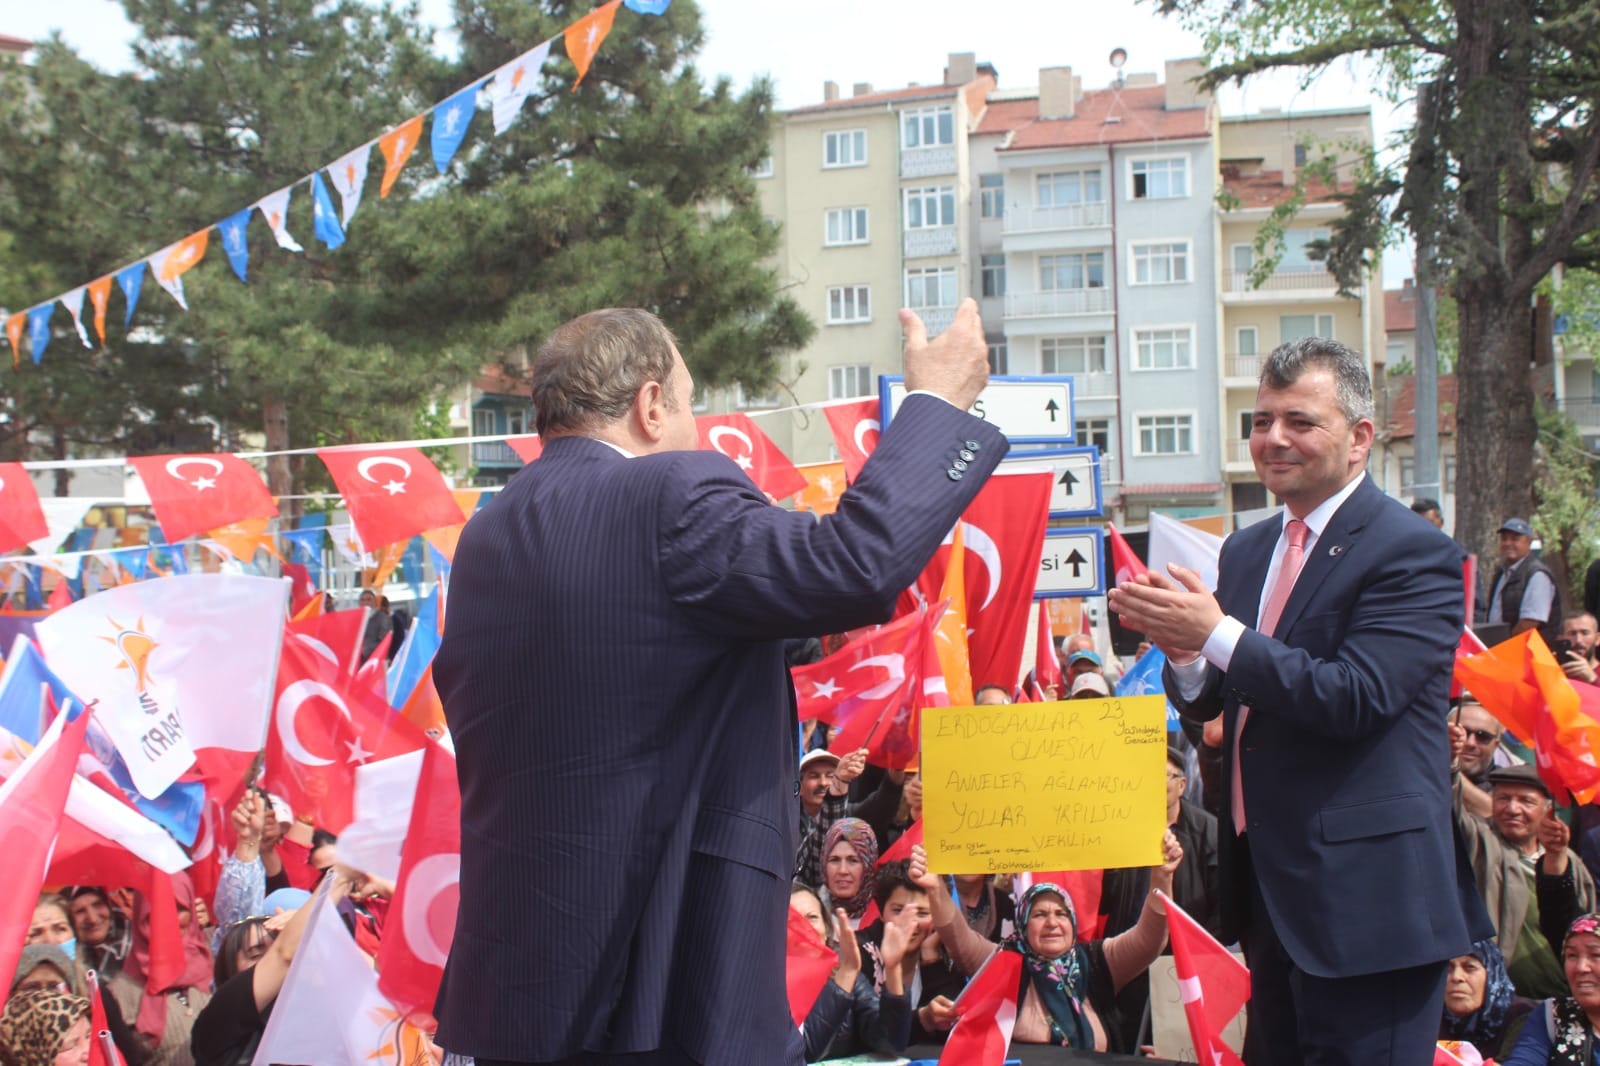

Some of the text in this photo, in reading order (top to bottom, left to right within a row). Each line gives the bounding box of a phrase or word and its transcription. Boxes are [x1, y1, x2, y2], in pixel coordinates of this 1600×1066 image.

[1098, 700, 1125, 720] 23
[936, 711, 1084, 739] ERDOĞANLAR
[945, 769, 1027, 793] ANNELER
[948, 801, 1027, 834] YOLLAR
